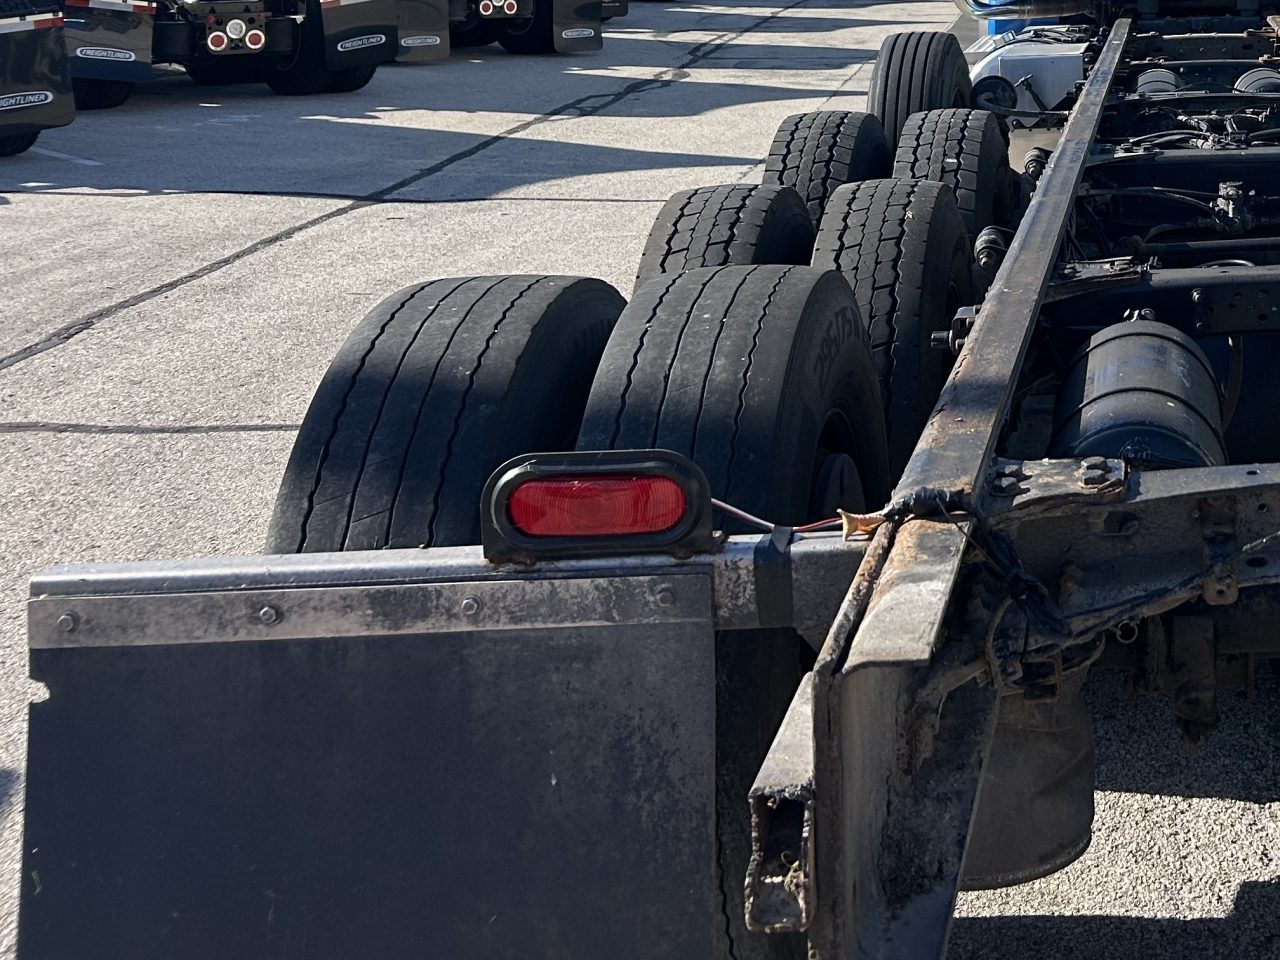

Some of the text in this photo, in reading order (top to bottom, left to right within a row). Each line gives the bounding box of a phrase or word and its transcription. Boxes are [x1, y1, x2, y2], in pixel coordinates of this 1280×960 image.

[342, 36, 381, 49] FREIGHTLINER
[82, 49, 131, 59] FREIGHTLINER
[0, 93, 46, 107] IGHTLINER
